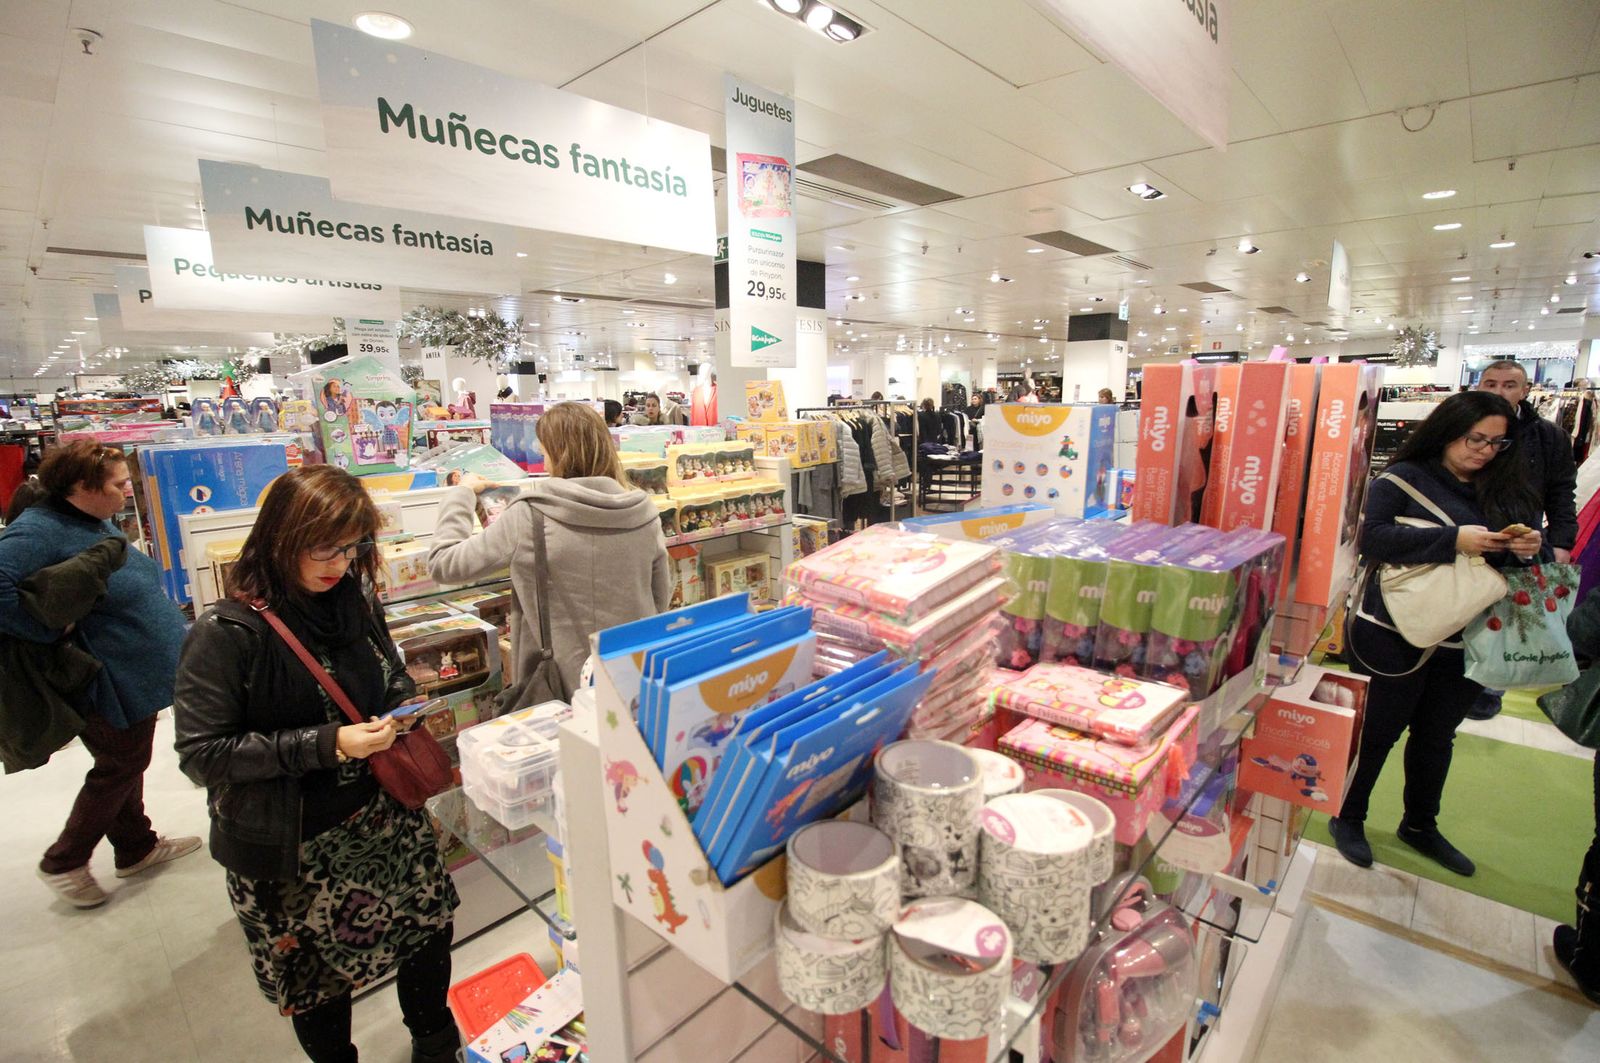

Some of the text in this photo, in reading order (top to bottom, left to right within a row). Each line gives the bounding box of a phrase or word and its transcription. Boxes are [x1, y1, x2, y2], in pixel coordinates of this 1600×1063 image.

[732, 87, 792, 123] Juguetes
[377, 97, 687, 197] Muñecas fantasía
[245, 206, 493, 255] Muñecas fantasía
[748, 280, 786, 300] 29,95€
[360, 344, 390, 353] 39,95€
[1016, 411, 1052, 426] miyo
[1149, 406, 1171, 452] miyo
[1218, 397, 1232, 432] miyo
[1326, 400, 1346, 438] miyo
[1238, 456, 1263, 504] miyo
[978, 520, 1008, 537] miyo
[1513, 652, 1538, 662] Corte
[728, 670, 768, 698] miyo
[1278, 709, 1316, 724] miyo
[786, 746, 835, 779] miyo
[1177, 820, 1203, 832] miyo
